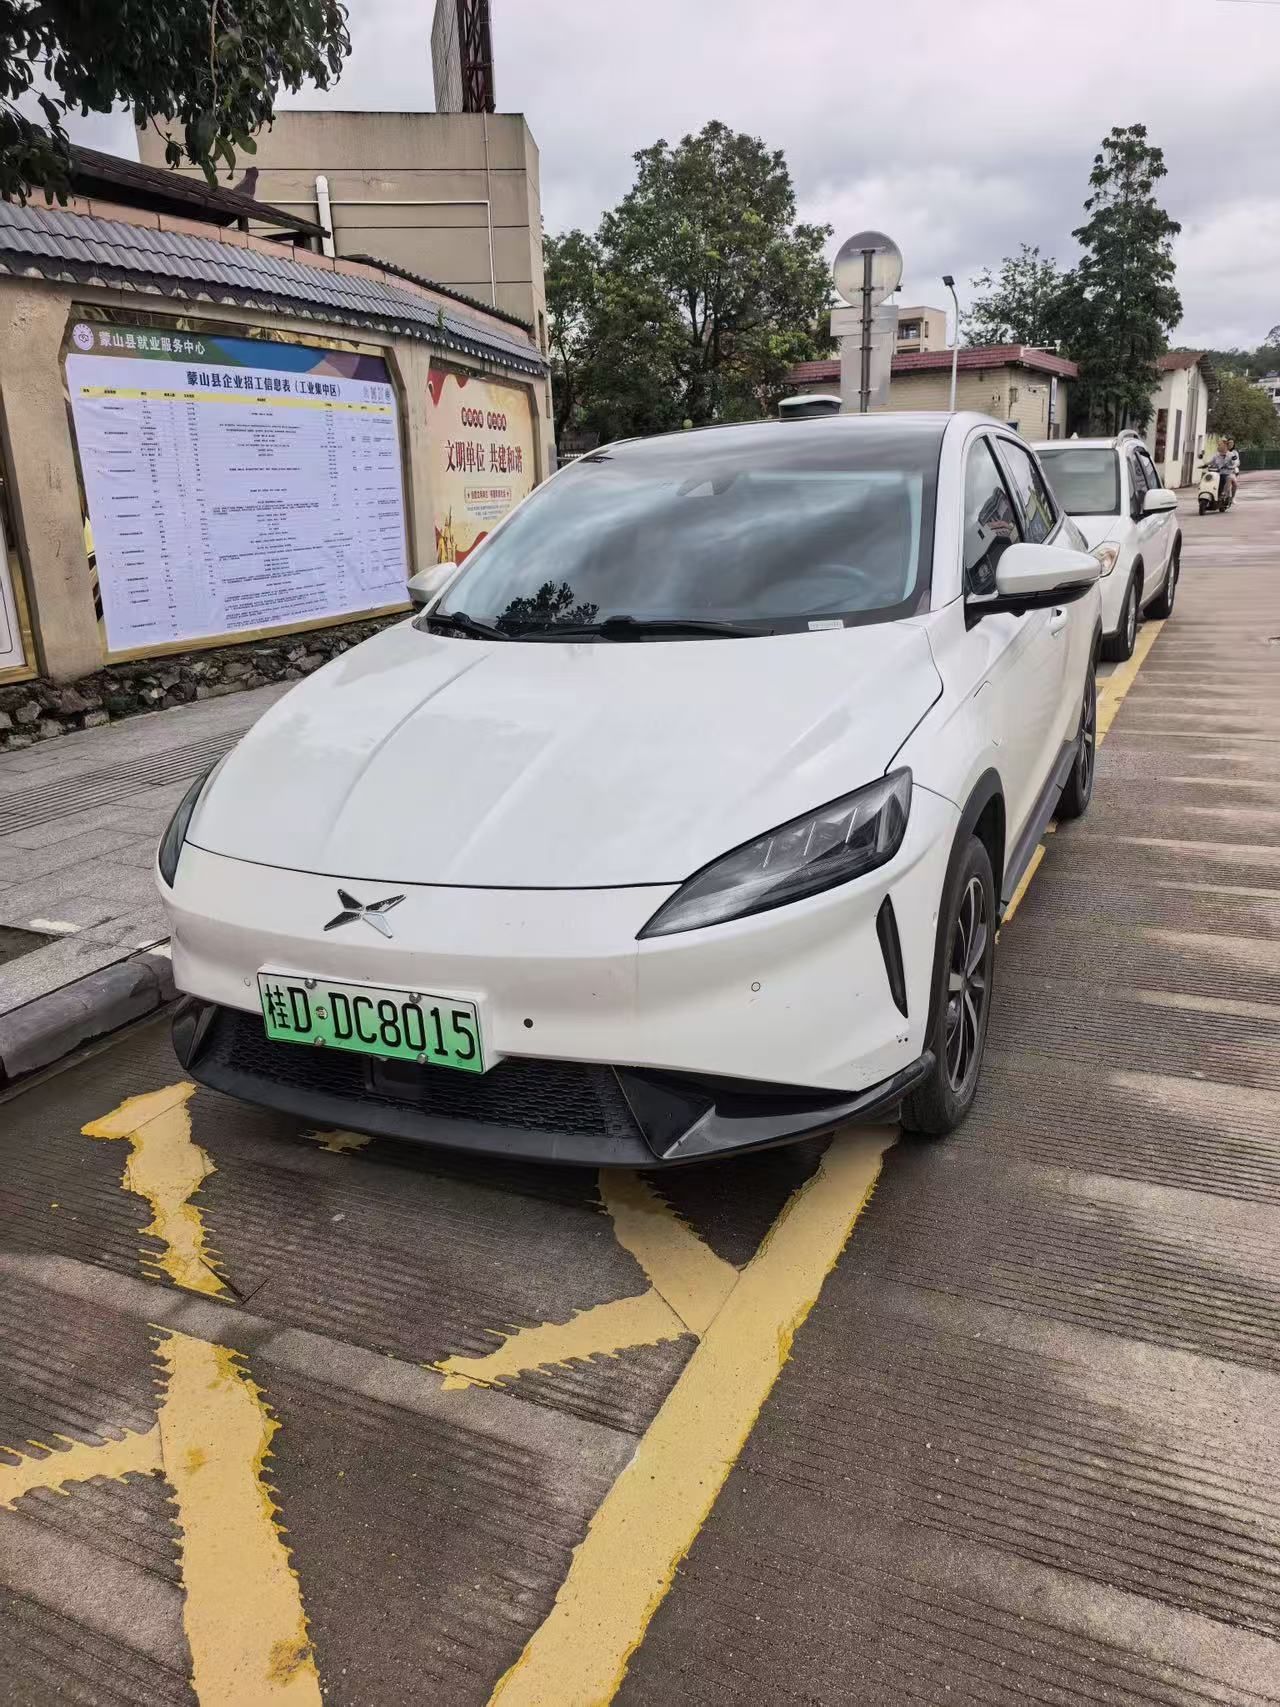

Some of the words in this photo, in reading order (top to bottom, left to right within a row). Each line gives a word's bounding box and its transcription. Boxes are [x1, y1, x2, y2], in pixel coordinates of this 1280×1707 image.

[98, 330, 206, 355] 蒙山县就业服务中心
[186, 370, 341, 398] 蒙山县企业招工信息表（工业集中区）
[445, 439, 485, 472] 文明单位
[490, 443, 522, 474] 共建和谐
